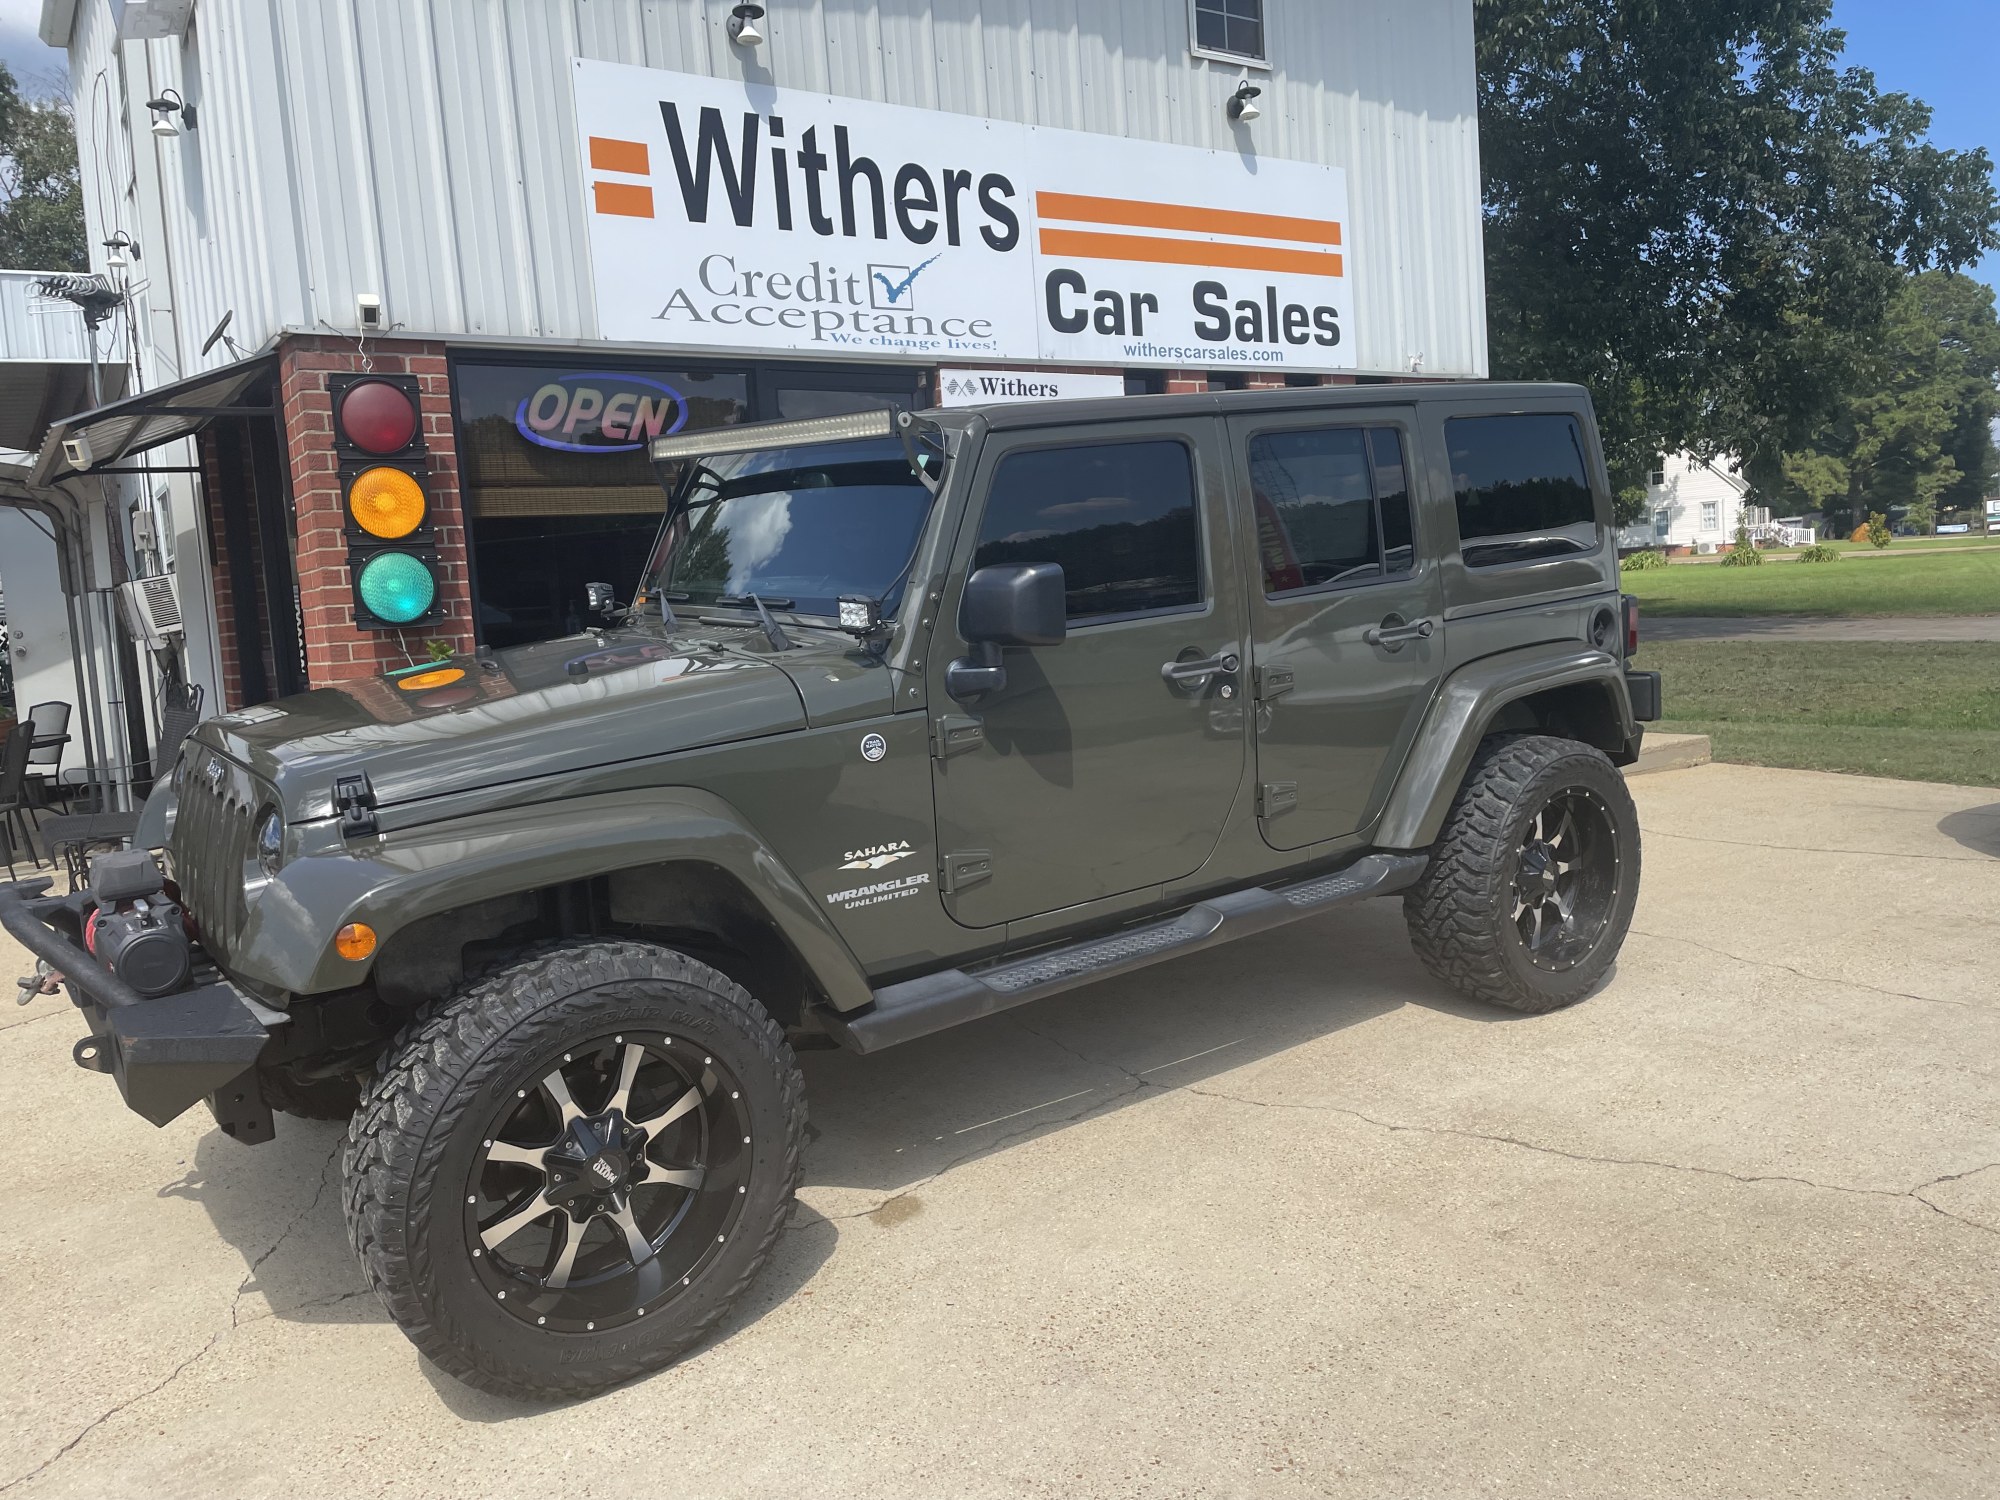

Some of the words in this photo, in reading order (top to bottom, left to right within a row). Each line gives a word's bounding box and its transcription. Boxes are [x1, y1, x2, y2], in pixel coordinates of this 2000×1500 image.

[658, 100, 1020, 252] Withers
[698, 254, 863, 306] Credit
[651, 287, 993, 342] Acceptance
[1045, 268, 1159, 337] Car
[1192, 280, 1341, 347] Sales
[830, 332, 862, 345] We
[869, 335, 941, 351] change
[948, 338, 997, 351] lives!
[1124, 341, 1284, 363] witherscarsales.com
[979, 377, 1059, 398] Withers
[528, 383, 671, 442] OPEN
[844, 840, 910, 860] SAHARA
[827, 873, 930, 903] WRANGLER
[844, 887, 919, 910] UNLIMITED
[592, 1162, 618, 1184] MOTO
